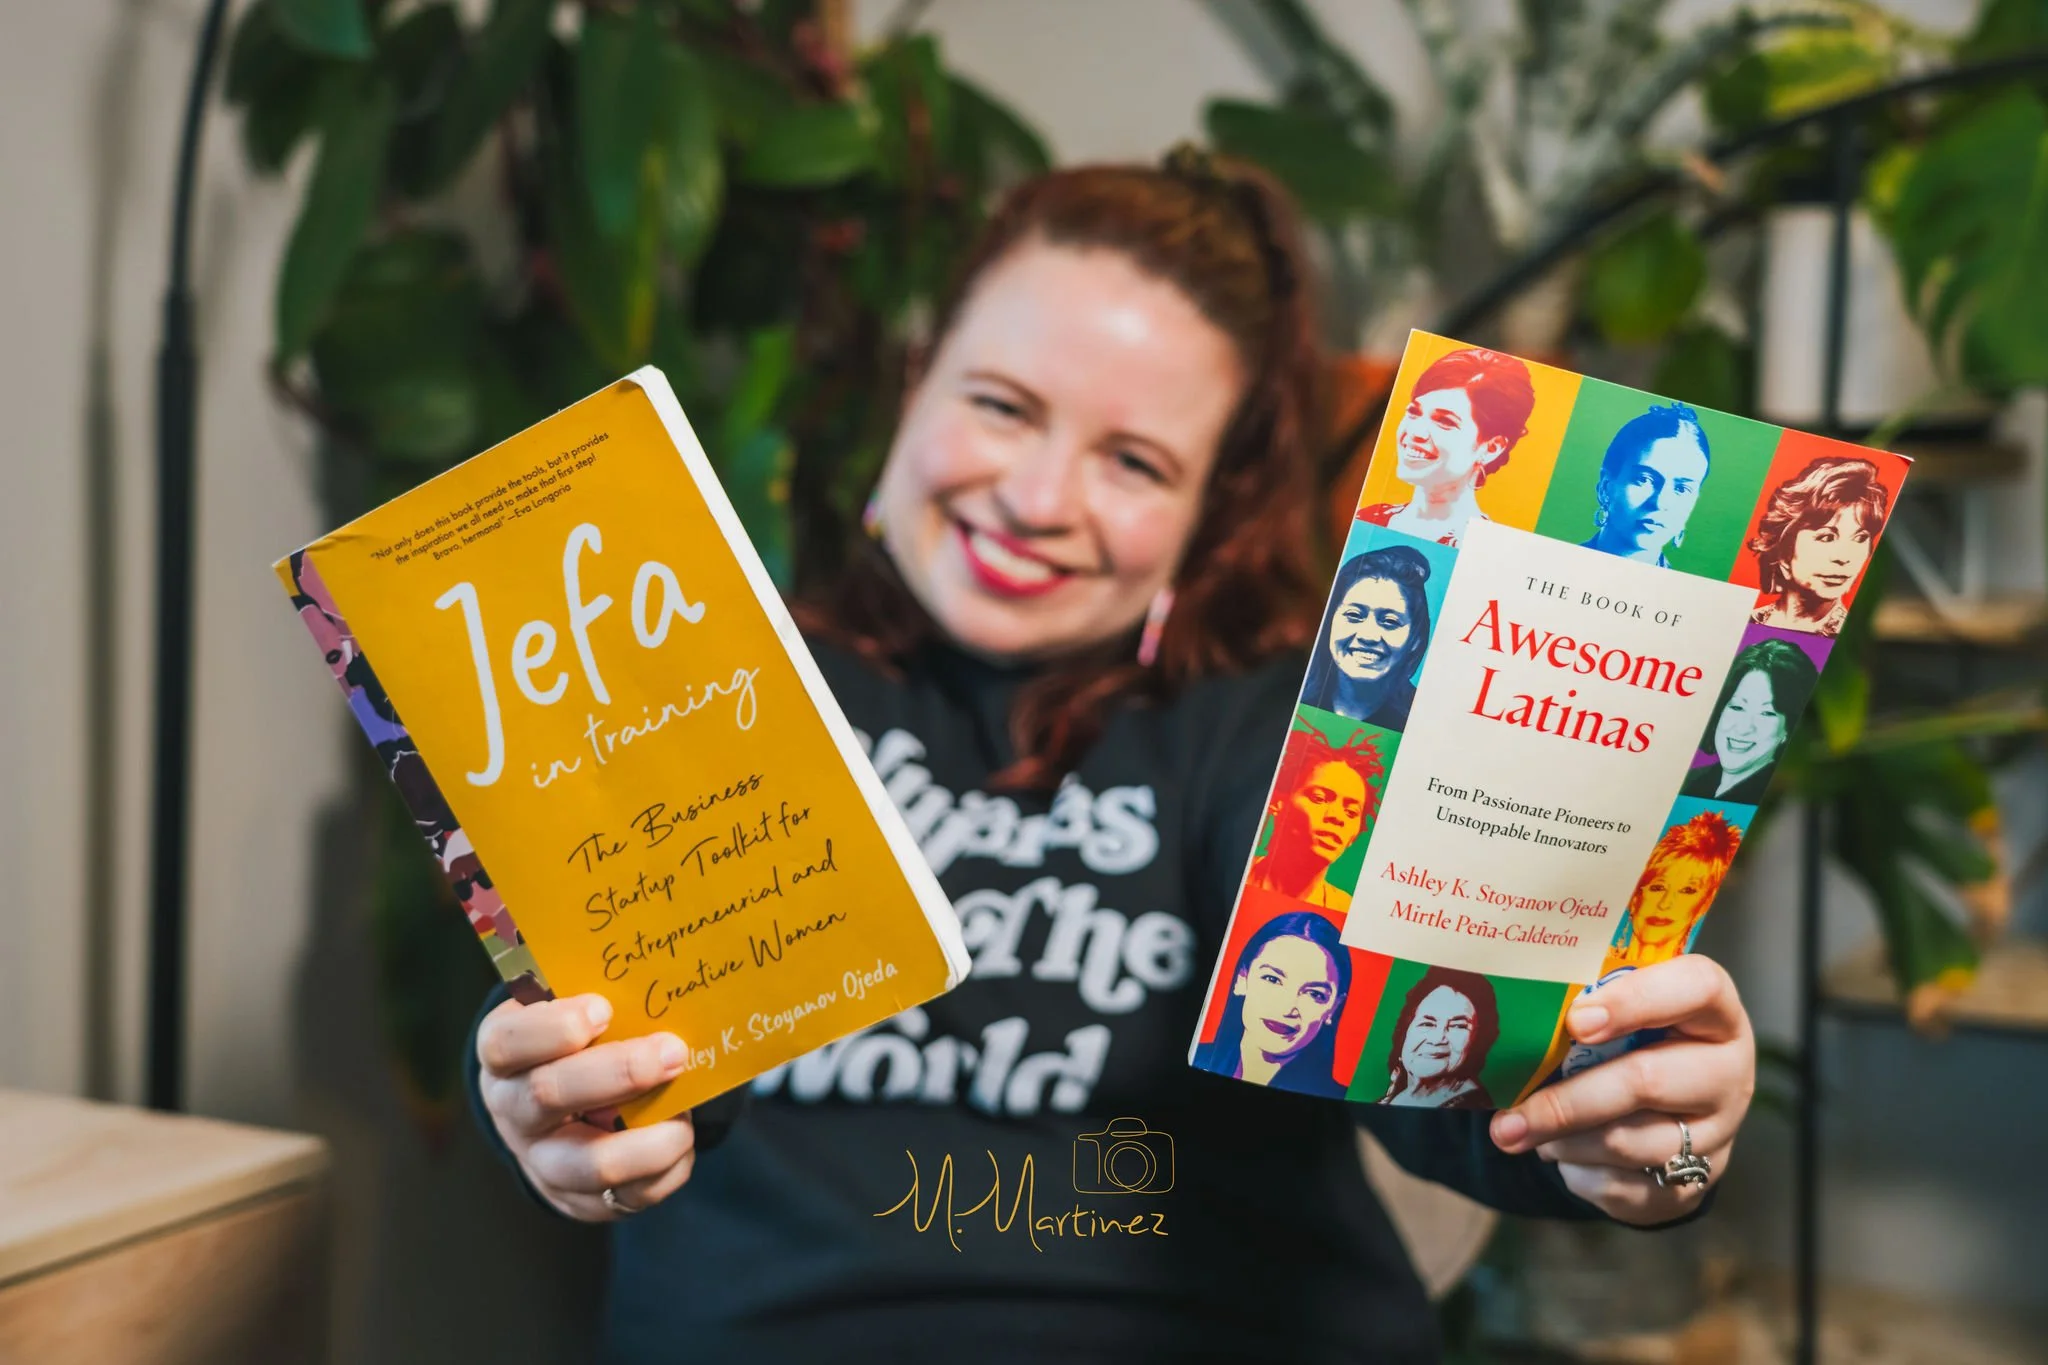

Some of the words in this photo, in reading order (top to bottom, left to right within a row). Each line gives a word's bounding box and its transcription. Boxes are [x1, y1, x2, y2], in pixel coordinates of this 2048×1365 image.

[394, 536, 412, 551] only
[414, 526, 435, 540] does
[435, 515, 451, 529] this
[450, 502, 474, 520] book
[475, 486, 507, 509] provide
[508, 479, 522, 490] the
[523, 466, 548, 482] tools,
[546, 455, 562, 469] but
[562, 452, 570, 461] it
[571, 432, 609, 459] provides
[395, 553, 409, 565] the
[411, 530, 455, 556] inspiration
[456, 523, 468, 533] we
[470, 513, 481, 526] all
[482, 502, 504, 519] need
[505, 499, 515, 508] to
[515, 485, 539, 501] make
[539, 475, 557, 488] that
[557, 465, 575, 479] first
[575, 453, 597, 470] step!
[433, 544, 462, 561] Bravo,
[532, 484, 571, 509] Longoria
[1459, 599, 1703, 697] Awesome
[1526, 576, 1570, 600] THE
[1580, 591, 1644, 619] BOOK
[1654, 610, 1682, 628] OF
[434, 522, 706, 787] Jefa
[530, 757, 581, 788] in
[583, 668, 760, 765] training
[1466, 665, 1655, 753] Latinas
[567, 833, 628, 872] The
[630, 773, 764, 848] Business
[1427, 776, 1468, 800] From
[1471, 788, 1552, 820] Passionate
[1554, 807, 1615, 832] Pioneers
[1617, 821, 1631, 834] to
[1436, 805, 1531, 841] Unstoppable
[1533, 829, 1608, 854] Innovators
[585, 872, 675, 932] Startup
[680, 812, 773, 876] Toolkit
[778, 801, 811, 838] for
[602, 866, 783, 981] Entrepreneurial
[792, 838, 838, 884] and
[1380, 861, 1448, 897] Ashley
[1450, 878, 1470, 899] K.
[1475, 884, 1558, 912] Stoyanov
[1559, 897, 1609, 919] Ojeda
[645, 959, 744, 1018] Creative
[749, 911, 846, 968] Women
[1389, 900, 1452, 930] Mirtle
[1454, 914, 1579, 948] Peña-Calderón
[721, 1026, 744, 1055] K.
[748, 991, 837, 1041] Stoyanov
[842, 959, 898, 1000] Ojeda
